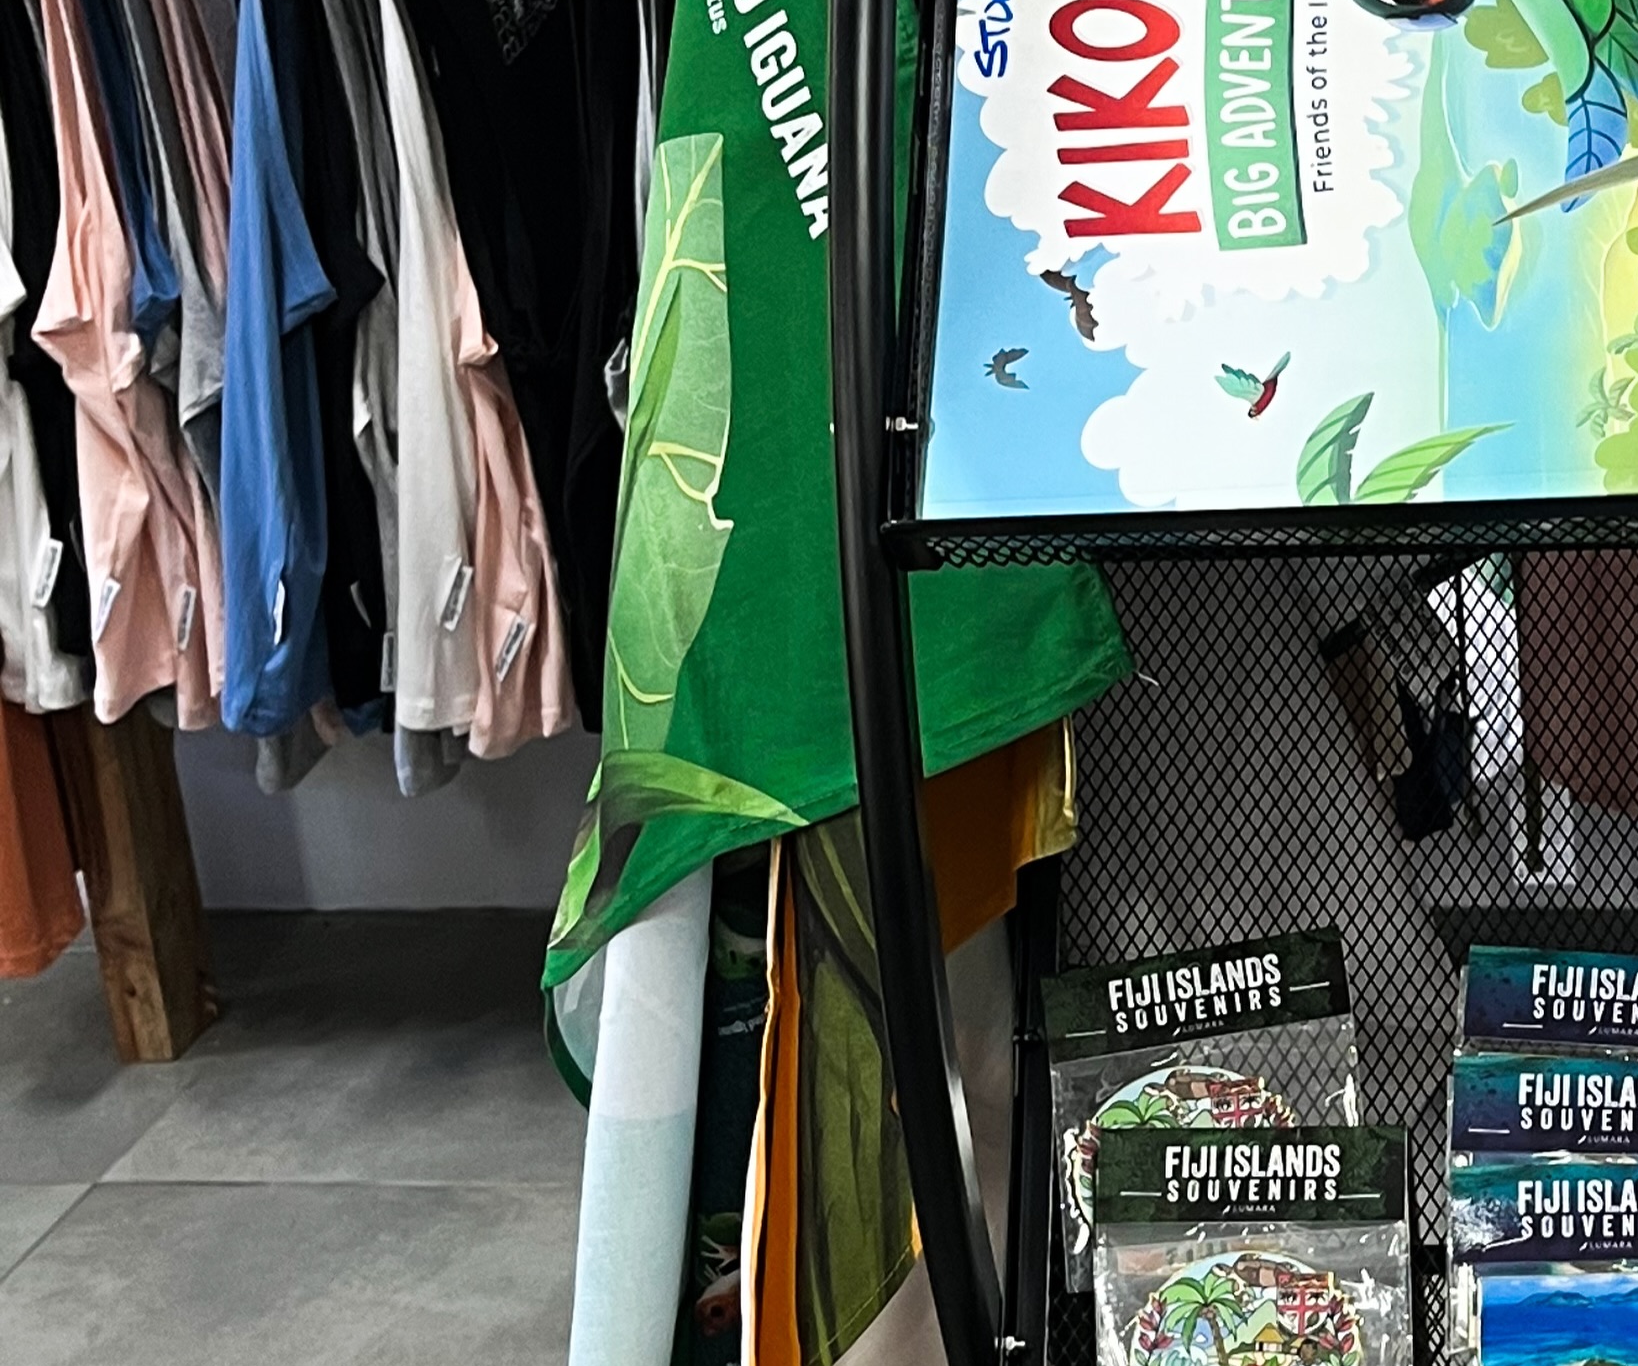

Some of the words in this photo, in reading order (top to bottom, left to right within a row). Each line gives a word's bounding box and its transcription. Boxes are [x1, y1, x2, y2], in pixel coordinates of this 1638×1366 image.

[1307, 16, 1327, 57] the
[1307, 67, 1327, 90] of
[1307, 98, 1333, 192] Friends
[1223, 162, 1287, 239] BIG
[1108, 973, 1161, 1011] FIJI
[1166, 953, 1281, 1002] ISLANDS
[1532, 964, 1584, 998] FIJI
[1116, 986, 1281, 1033] SOUVENIRS
[1518, 1073, 1570, 1107] FIJI
[1165, 1145, 1218, 1179] FIJI
[1224, 1144, 1341, 1178] ISLANDS
[1166, 1179, 1338, 1203] SOUVENIRS
[1517, 1180, 1570, 1215] FIJI
